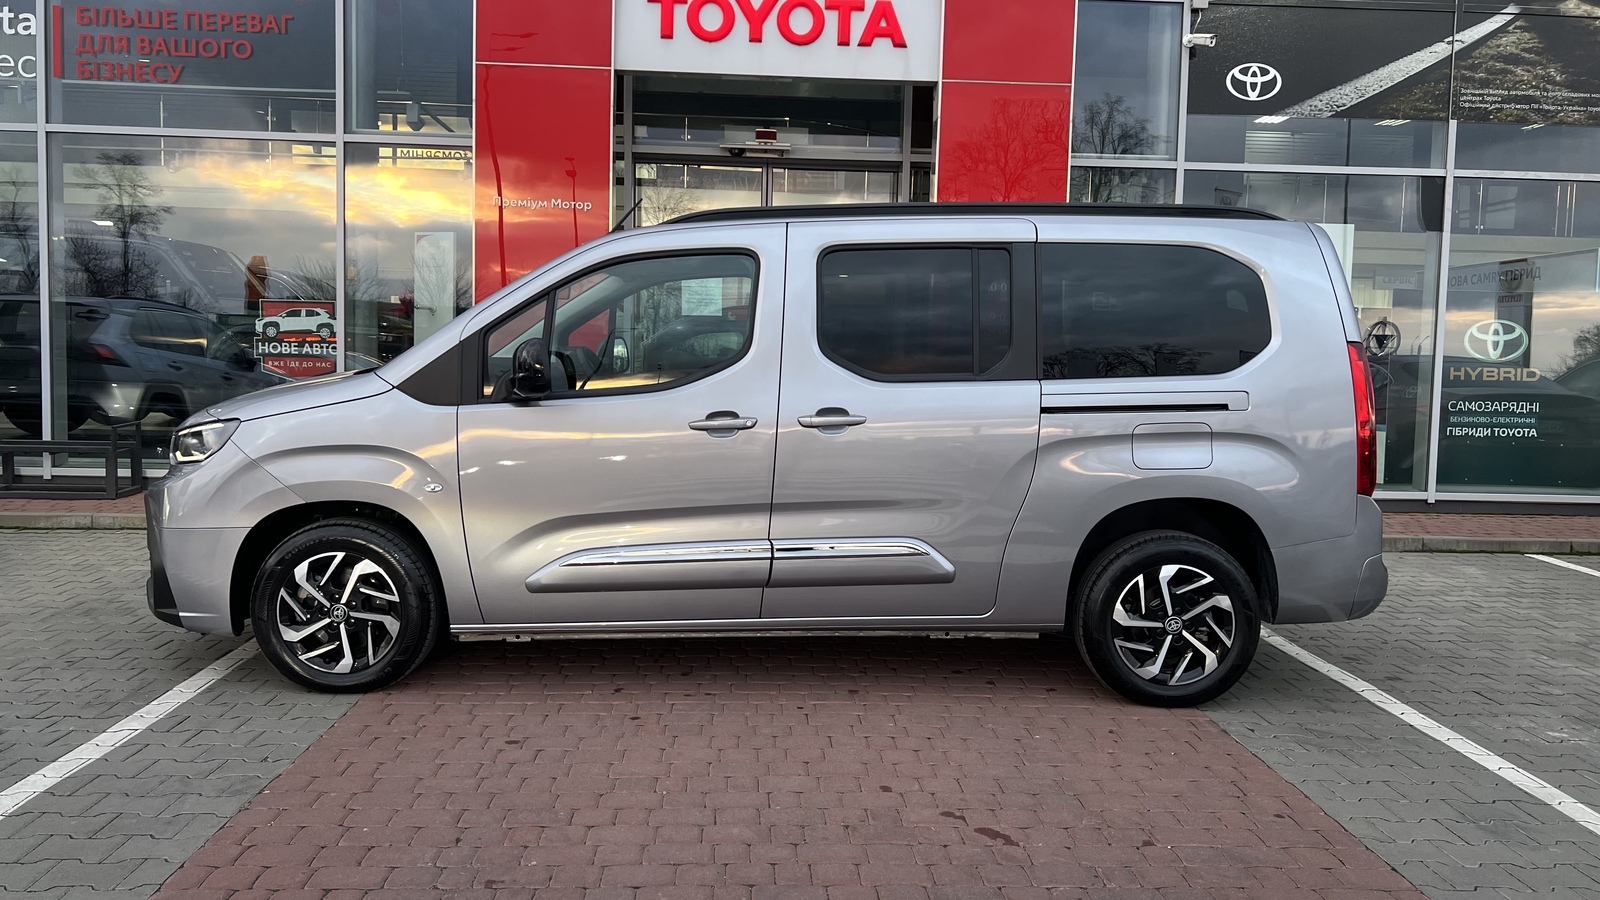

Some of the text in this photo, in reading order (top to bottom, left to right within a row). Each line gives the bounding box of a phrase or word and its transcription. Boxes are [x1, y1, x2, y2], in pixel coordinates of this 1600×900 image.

[76, 6, 294, 34] БІЛЬШЕ ПЕРЕВАГ
[647, 0, 908, 48] TOYOTA
[75, 33, 254, 59] ДЛЯ ВАШОГО
[77, 60, 183, 84] БІЗНЕСУ
[492, 196, 592, 211] Преміум Мотор
[258, 342, 337, 355] НОВЕ АВТО
[287, 360, 299, 368] ЇДЕ
[1449, 367, 1541, 382] HYBRID
[1448, 400, 1540, 414] САМОЗАРЯДНІ
[1450, 416, 1536, 424] БЕНЗИНОВО-ЕЛЕКТРИЧНІ
[1446, 427, 1537, 438] ГІБРИДИ TOYOTA
